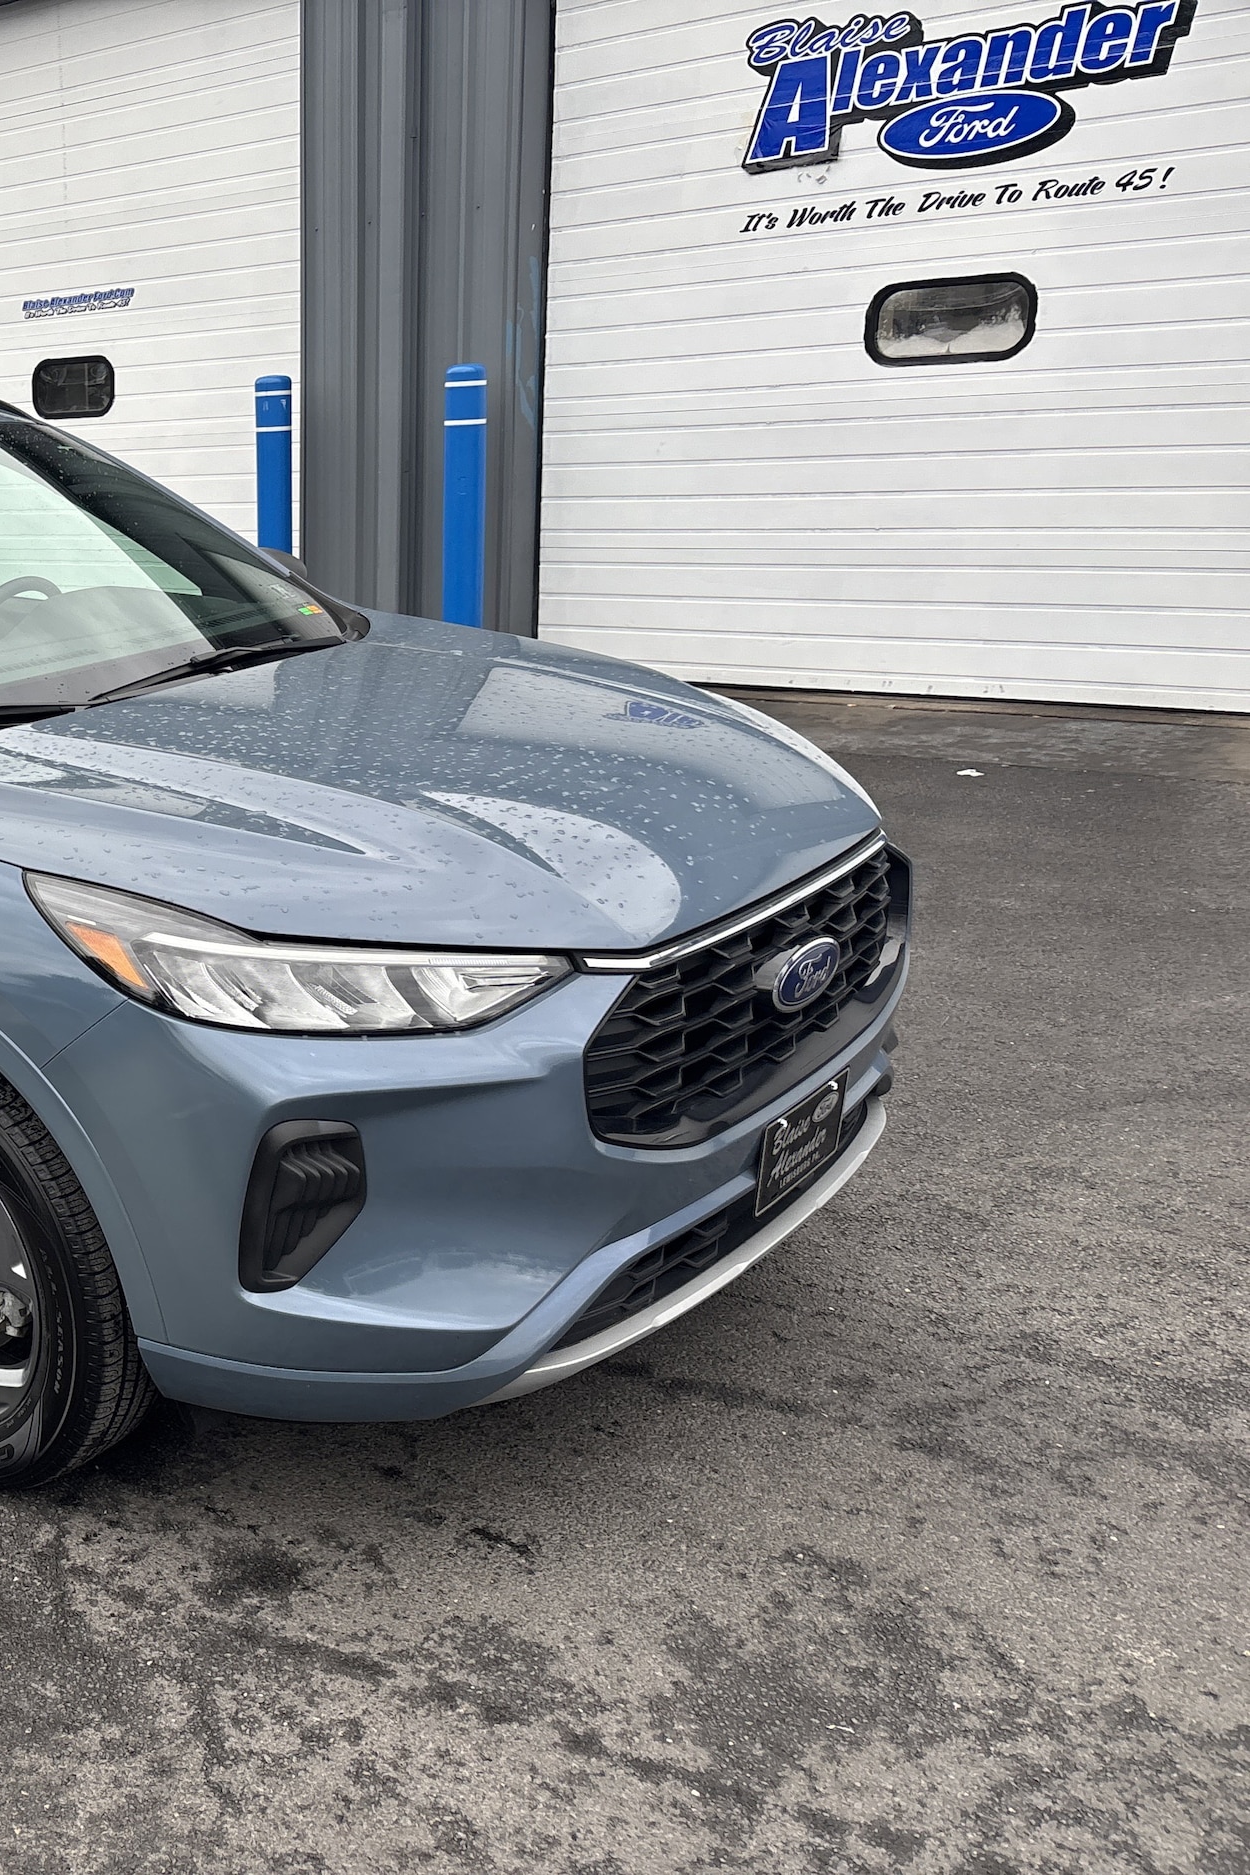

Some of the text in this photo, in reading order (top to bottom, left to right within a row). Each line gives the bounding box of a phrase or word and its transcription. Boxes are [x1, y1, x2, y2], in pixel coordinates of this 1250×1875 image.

[749, 13, 911, 65] Blaise
[742, 0, 1180, 165] Alexander
[918, 101, 1020, 148] Ford
[739, 212, 779, 233] It's
[786, 200, 857, 229] Worth
[865, 191, 906, 219] The
[917, 189, 987, 213] Drive
[994, 183, 1023, 205] To
[1031, 176, 1107, 202] Route
[794, 953, 831, 999] Ford
[766, 1126, 827, 1188] Alexander
[772, 1115, 811, 1156] Blaise
